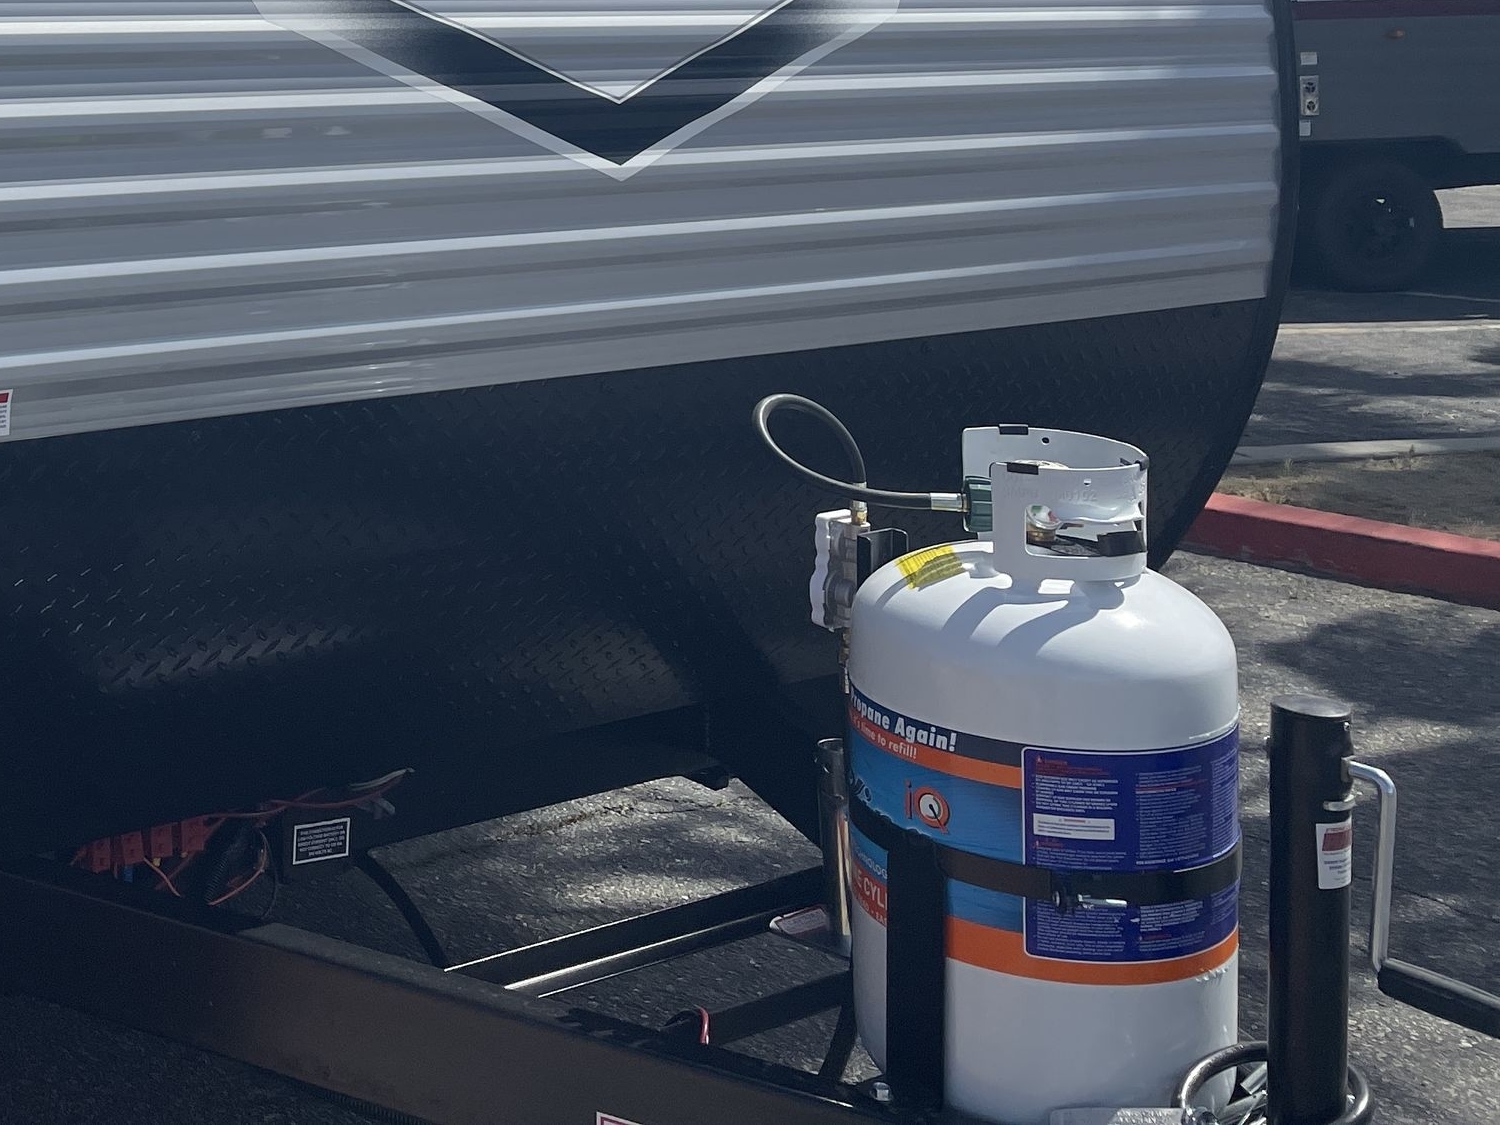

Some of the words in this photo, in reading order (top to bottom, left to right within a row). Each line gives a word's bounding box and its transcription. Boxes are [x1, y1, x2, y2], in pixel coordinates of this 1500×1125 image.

[877, 732, 887, 746] to
[888, 740, 917, 760] refill!
[894, 717, 958, 752] Again!
